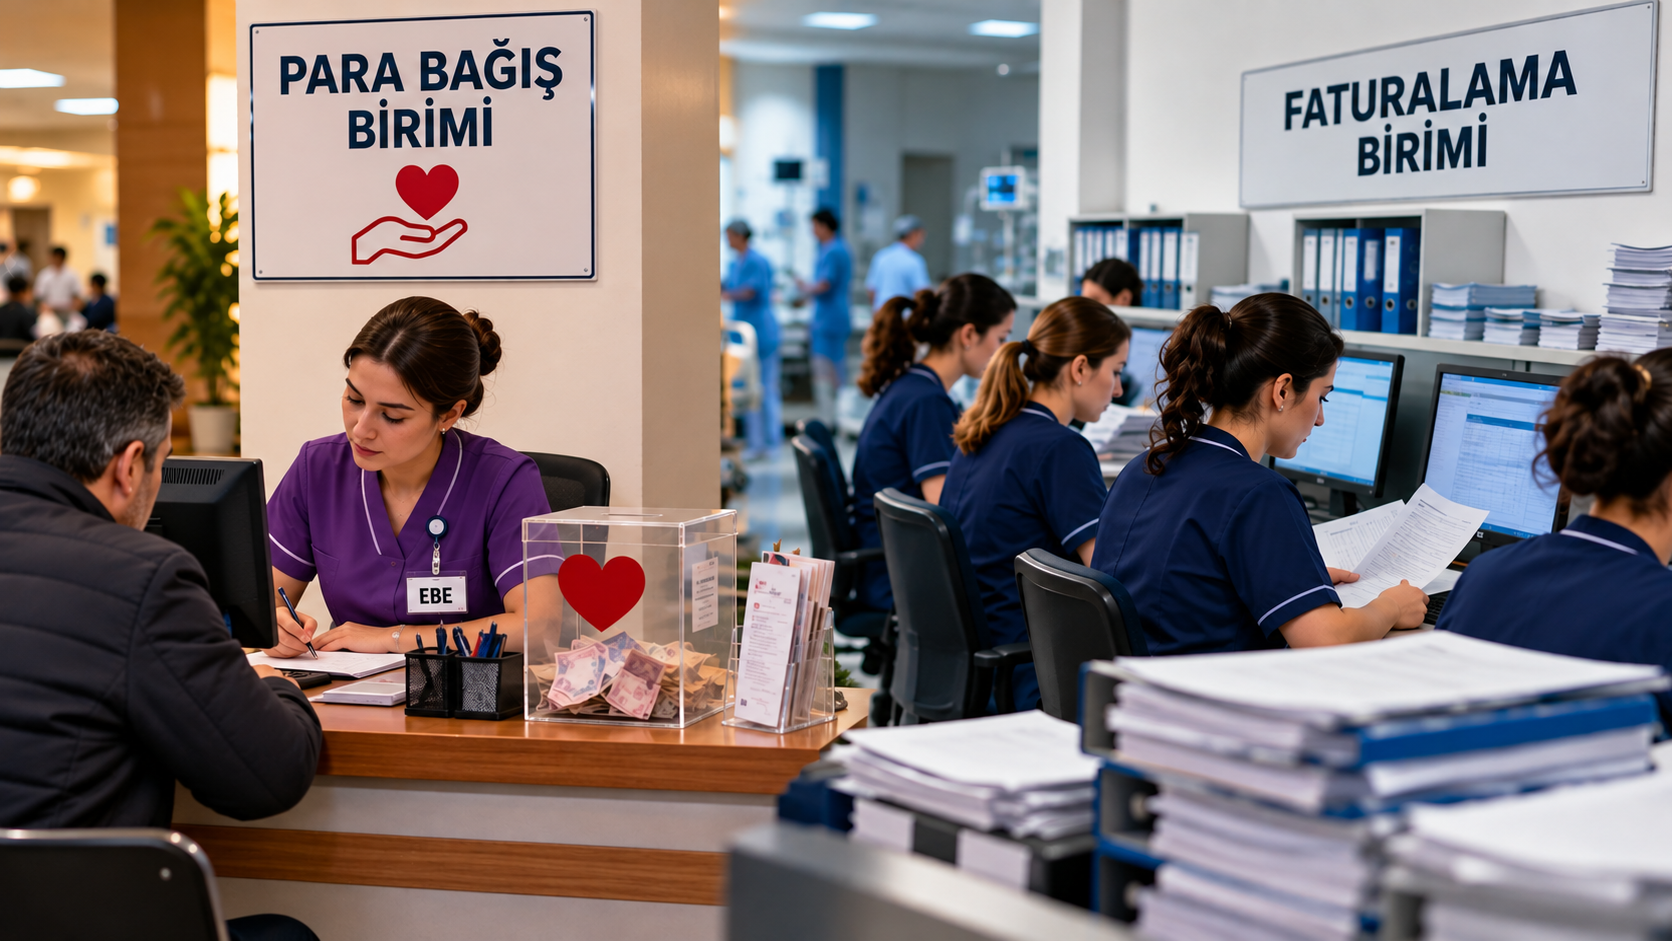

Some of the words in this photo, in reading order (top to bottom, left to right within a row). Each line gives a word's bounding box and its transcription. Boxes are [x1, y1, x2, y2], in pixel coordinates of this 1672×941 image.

[280, 53, 405, 96] PARA
[420, 37, 563, 101] BAĞIŞ
[1284, 49, 1578, 131] FATURALAMA
[348, 96, 493, 150] BİRİMİ
[1357, 112, 1488, 177] BİRİMİ
[419, 587, 453, 605] EBE
